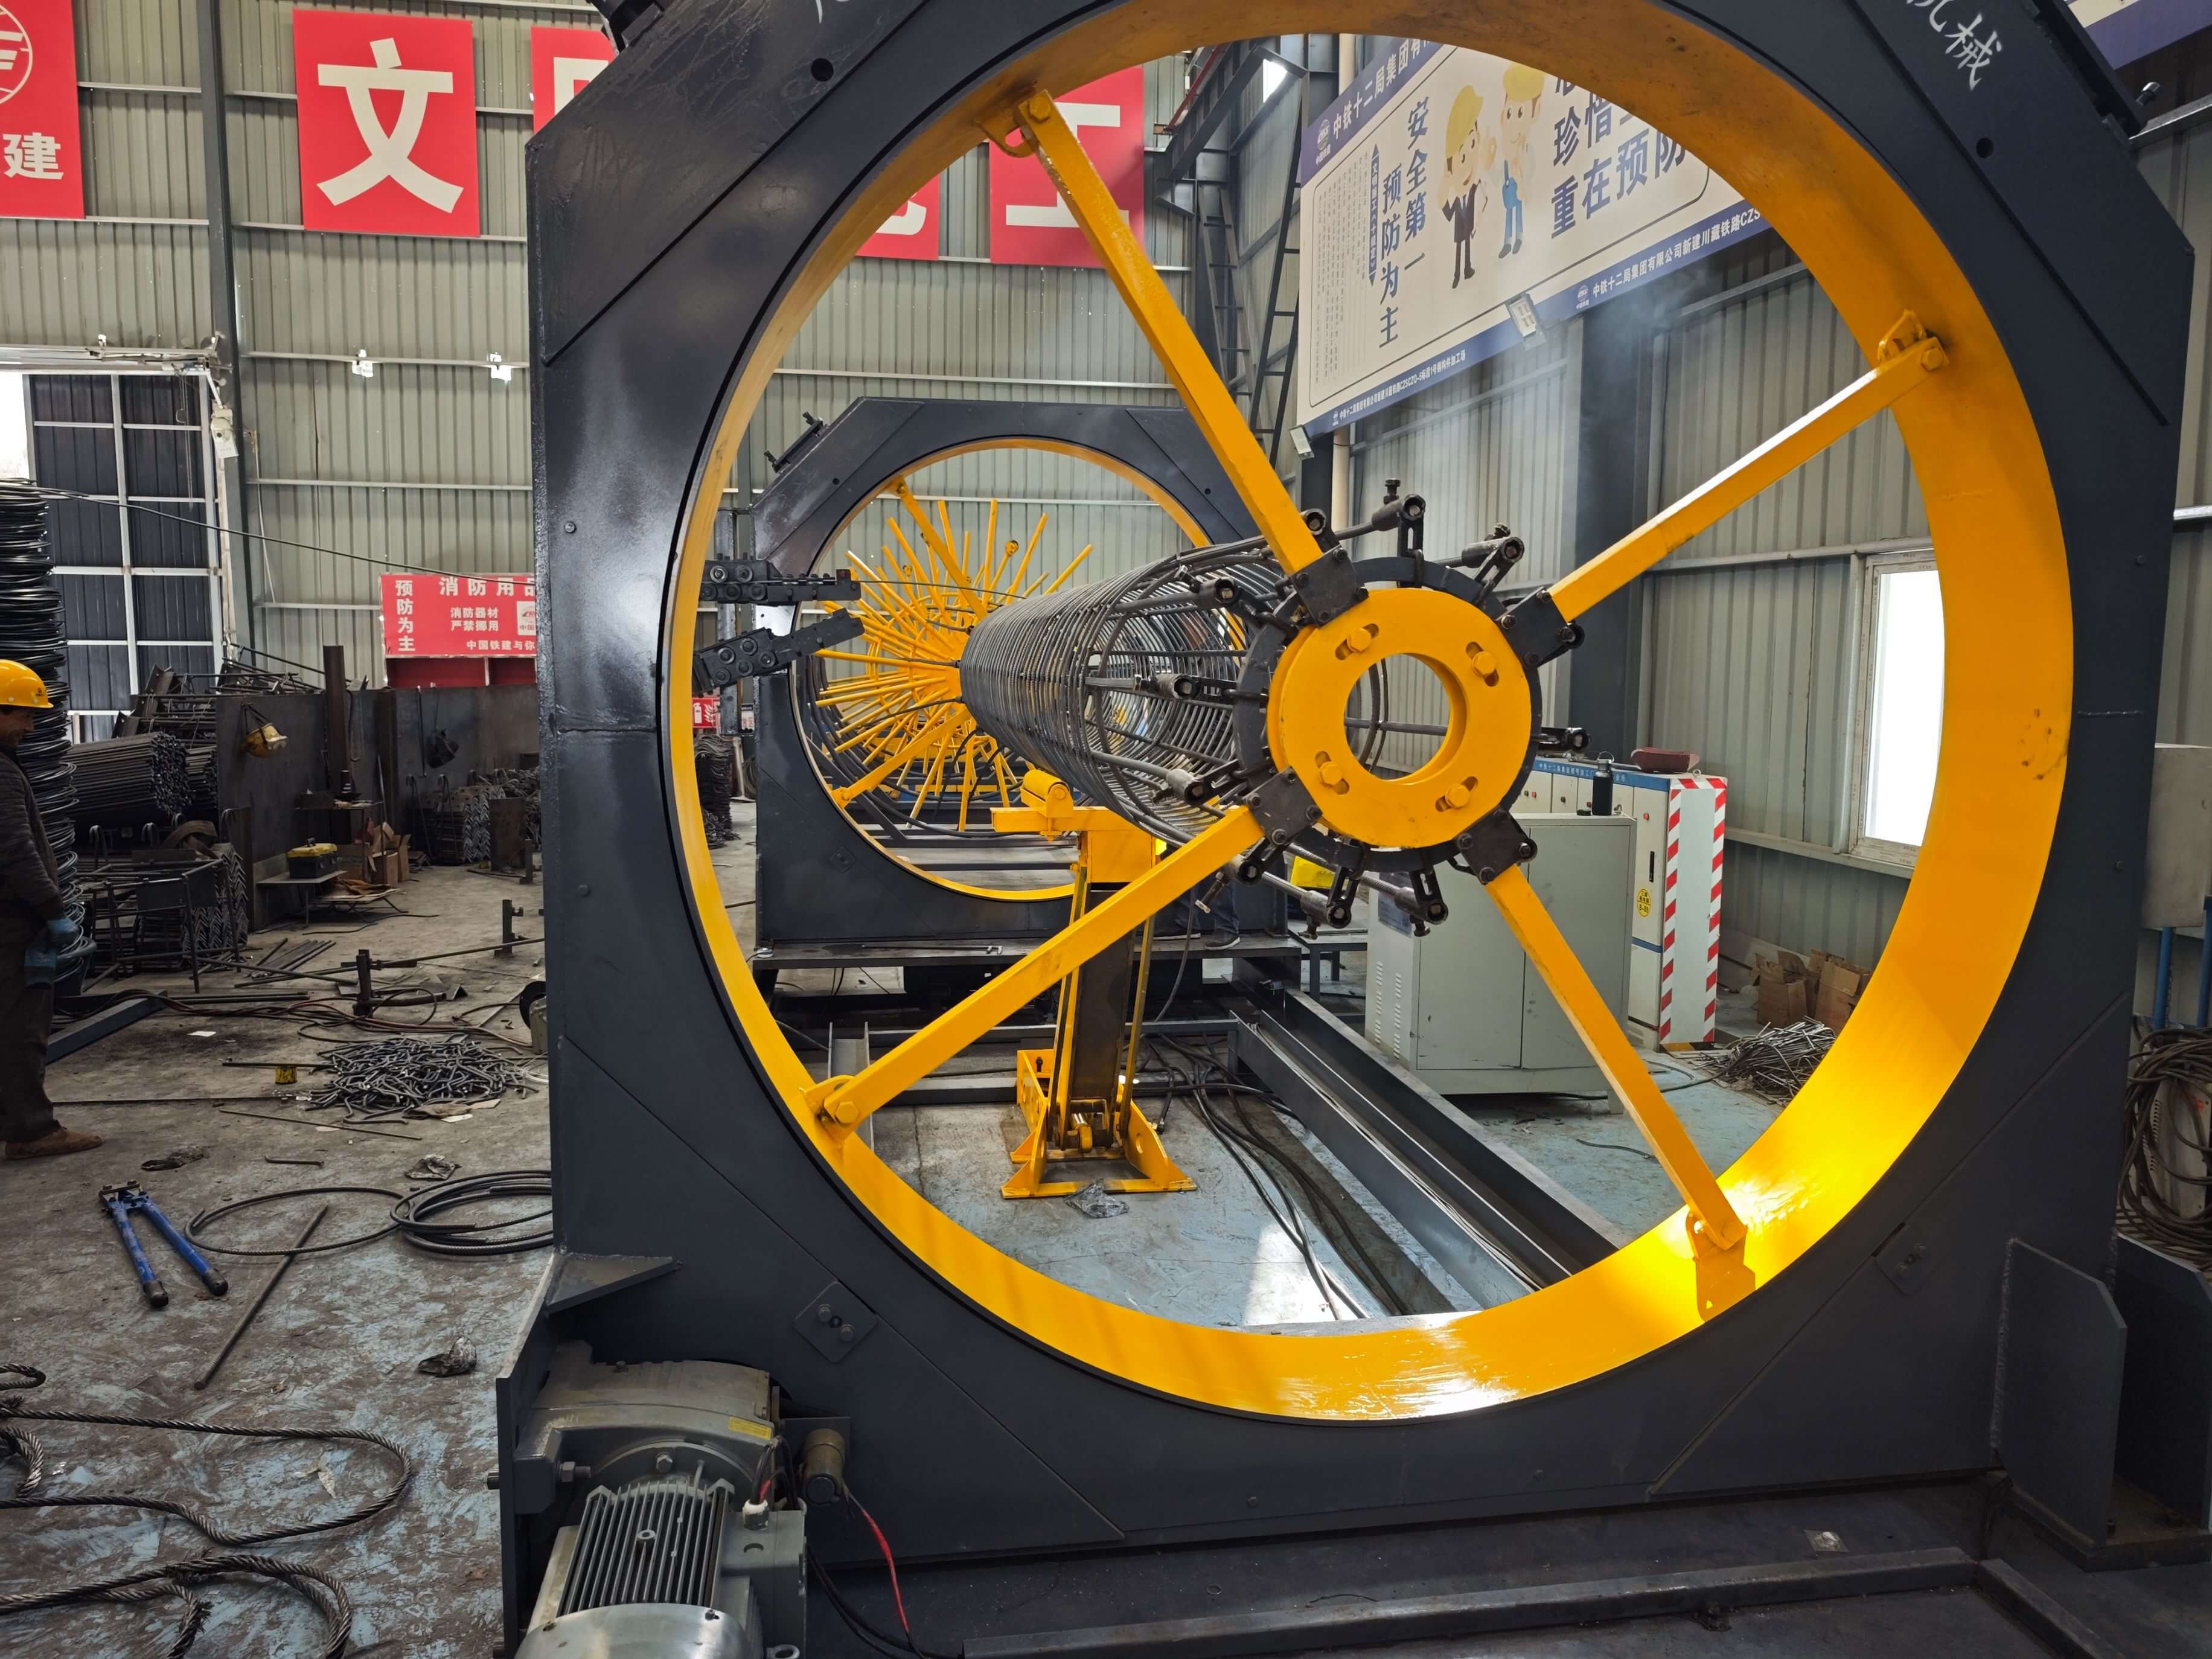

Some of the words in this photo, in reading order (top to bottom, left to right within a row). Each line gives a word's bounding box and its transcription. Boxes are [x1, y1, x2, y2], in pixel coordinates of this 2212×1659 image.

[317, 37, 464, 214] 文
[1333, 39, 1430, 140] 中铁十二局集团有
[1553, 92, 1633, 167] 珍惜
[1404, 96, 1430, 270] 安全第一
[1551, 128, 1686, 239] 重在预防
[1379, 162, 1402, 348] 预防为主
[395, 580, 415, 651] 预防为主
[450, 607, 499, 619] 消防器材
[450, 620, 499, 631] 严禁挪用
